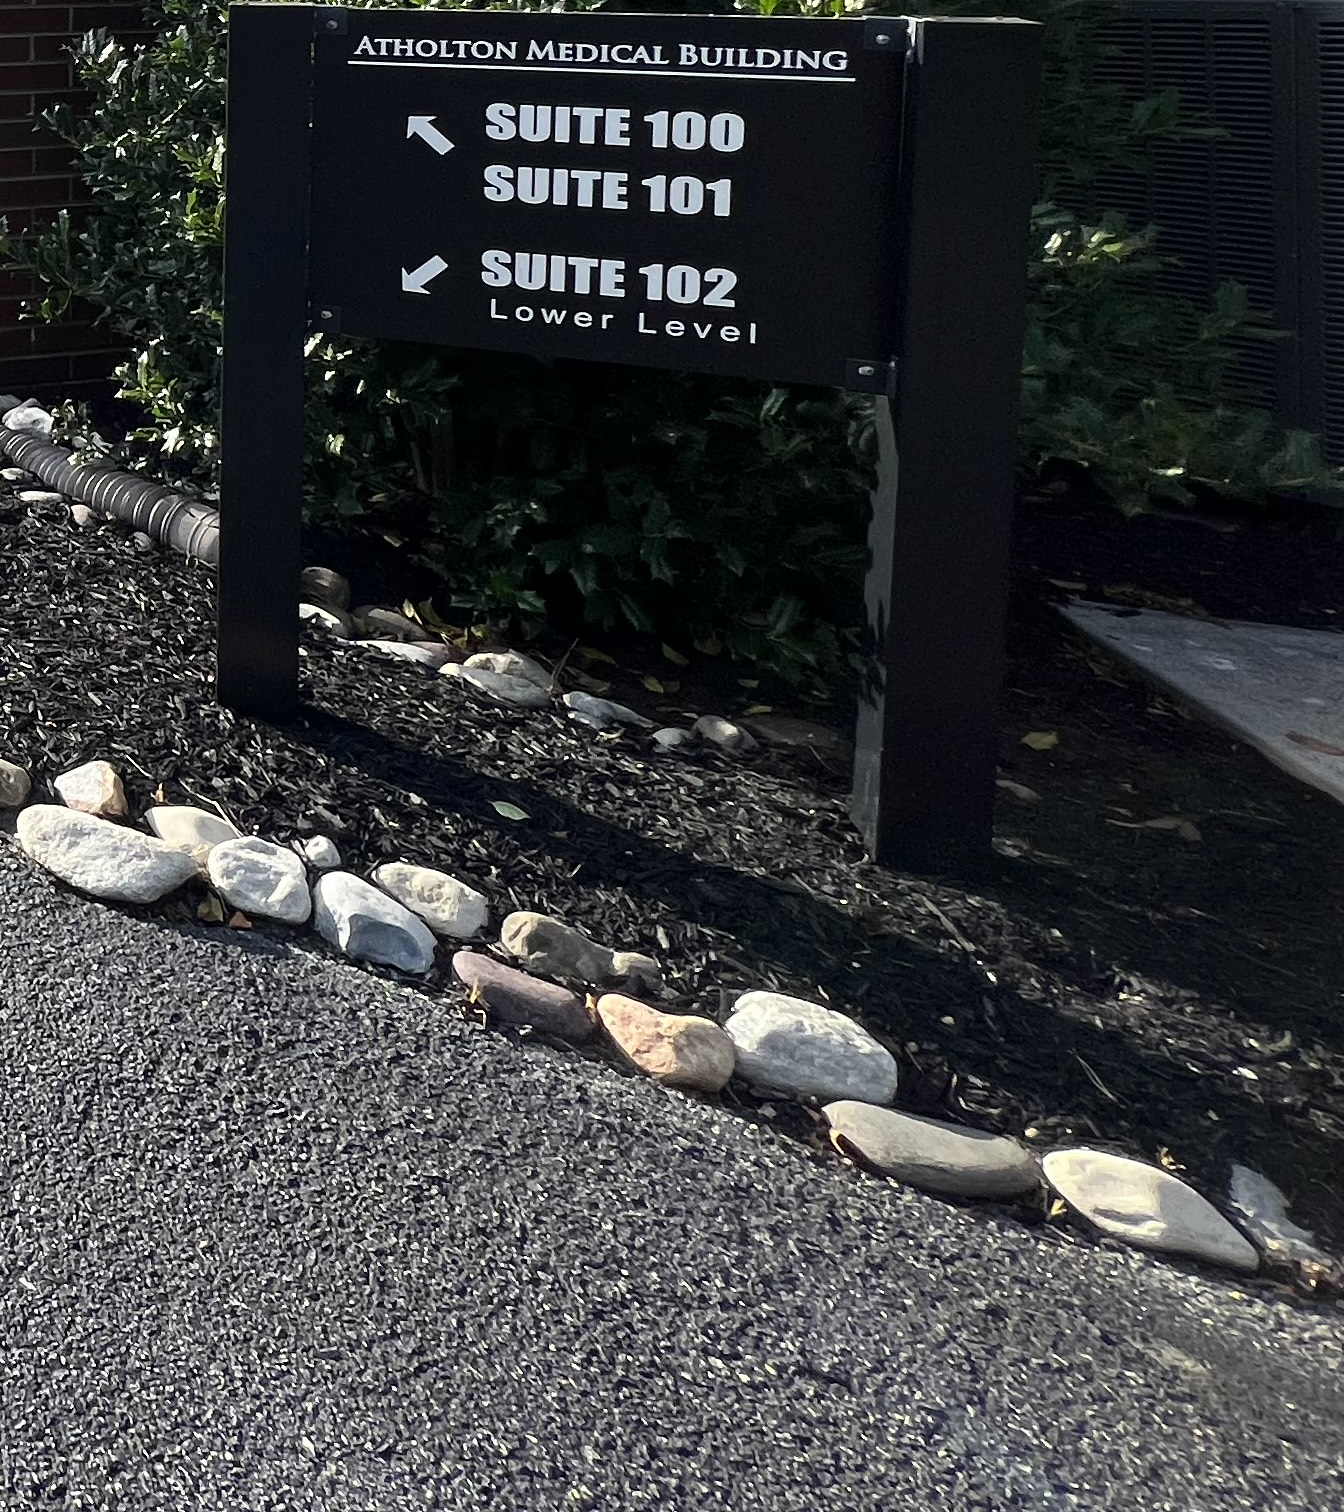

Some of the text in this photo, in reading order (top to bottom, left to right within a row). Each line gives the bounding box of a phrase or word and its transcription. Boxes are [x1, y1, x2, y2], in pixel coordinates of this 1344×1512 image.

[485, 102, 745, 153] SUITE 100
[483, 164, 732, 217] SUITE 101
[481, 249, 738, 308] SUITE 102
[490, 298, 757, 345] Lower Level
